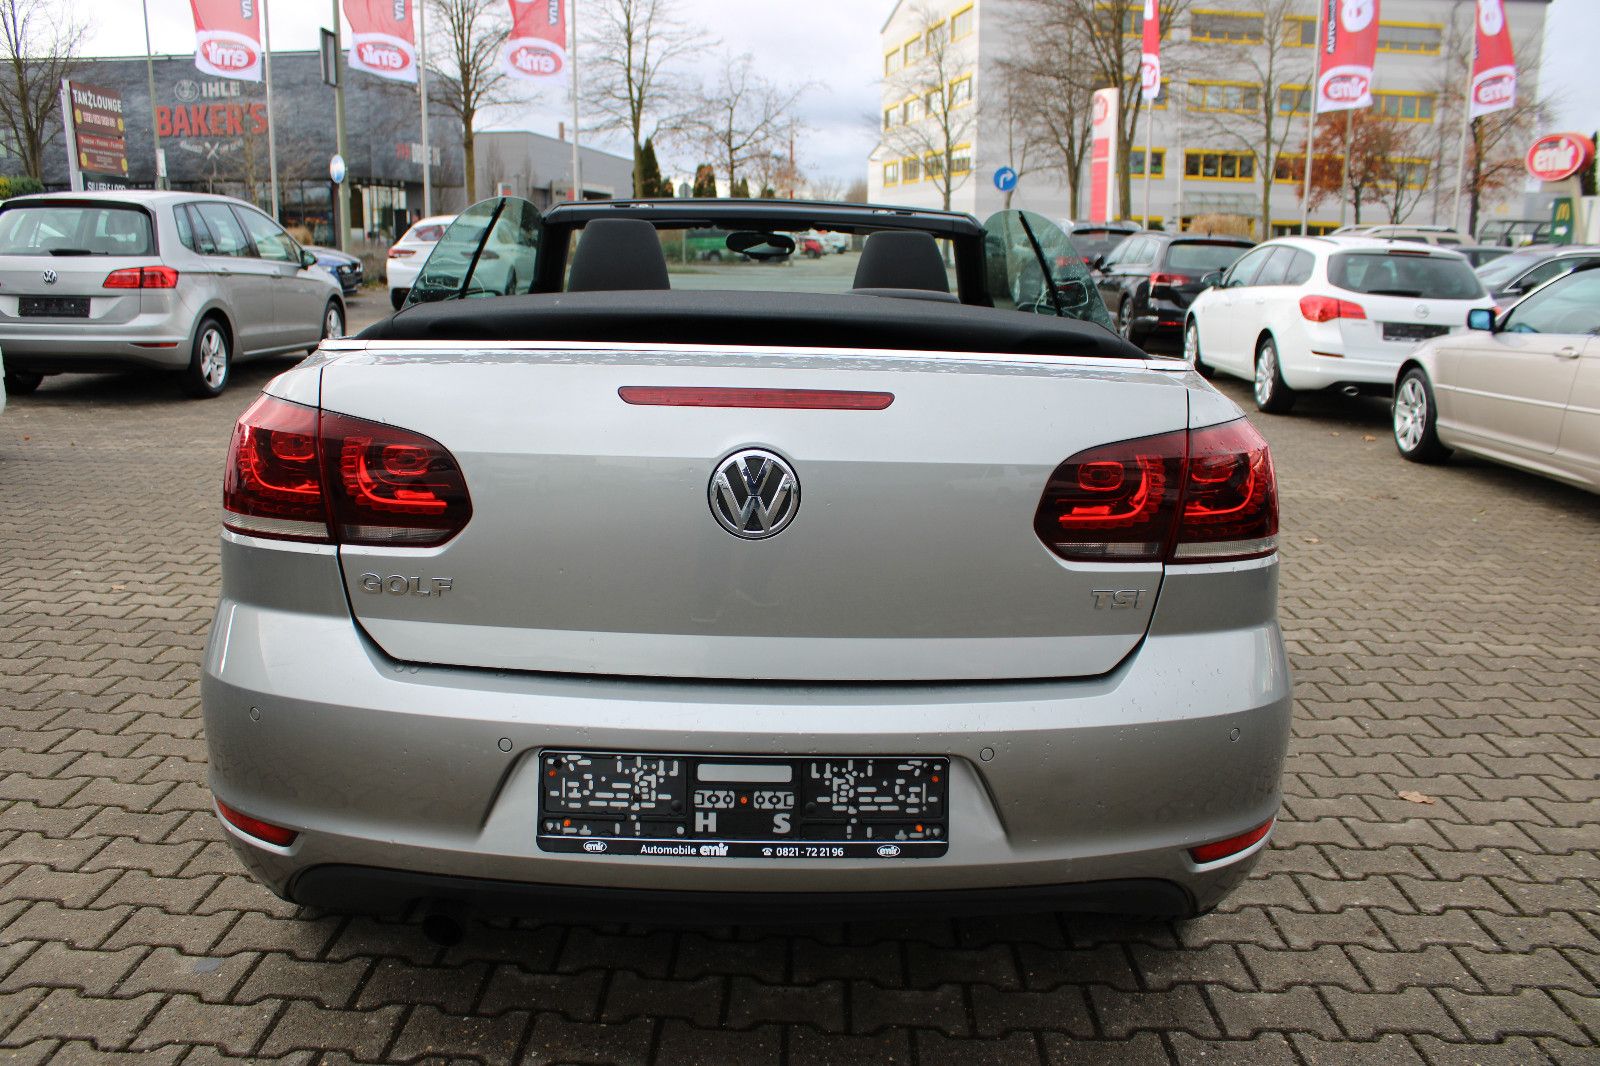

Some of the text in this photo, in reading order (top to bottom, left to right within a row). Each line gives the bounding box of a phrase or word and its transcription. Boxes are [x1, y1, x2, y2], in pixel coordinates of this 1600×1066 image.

[1328, 77, 1366, 99] emir
[156, 102, 268, 138] BAKER'S
[1533, 138, 1575, 171] emir
[360, 572, 453, 598] GOLF
[1090, 589, 1147, 609] TSI
[584, 841, 605, 852] emir
[640, 842, 729, 857] Automobile emir
[776, 847, 799, 857] 0821
[878, 845, 899, 857] emir
